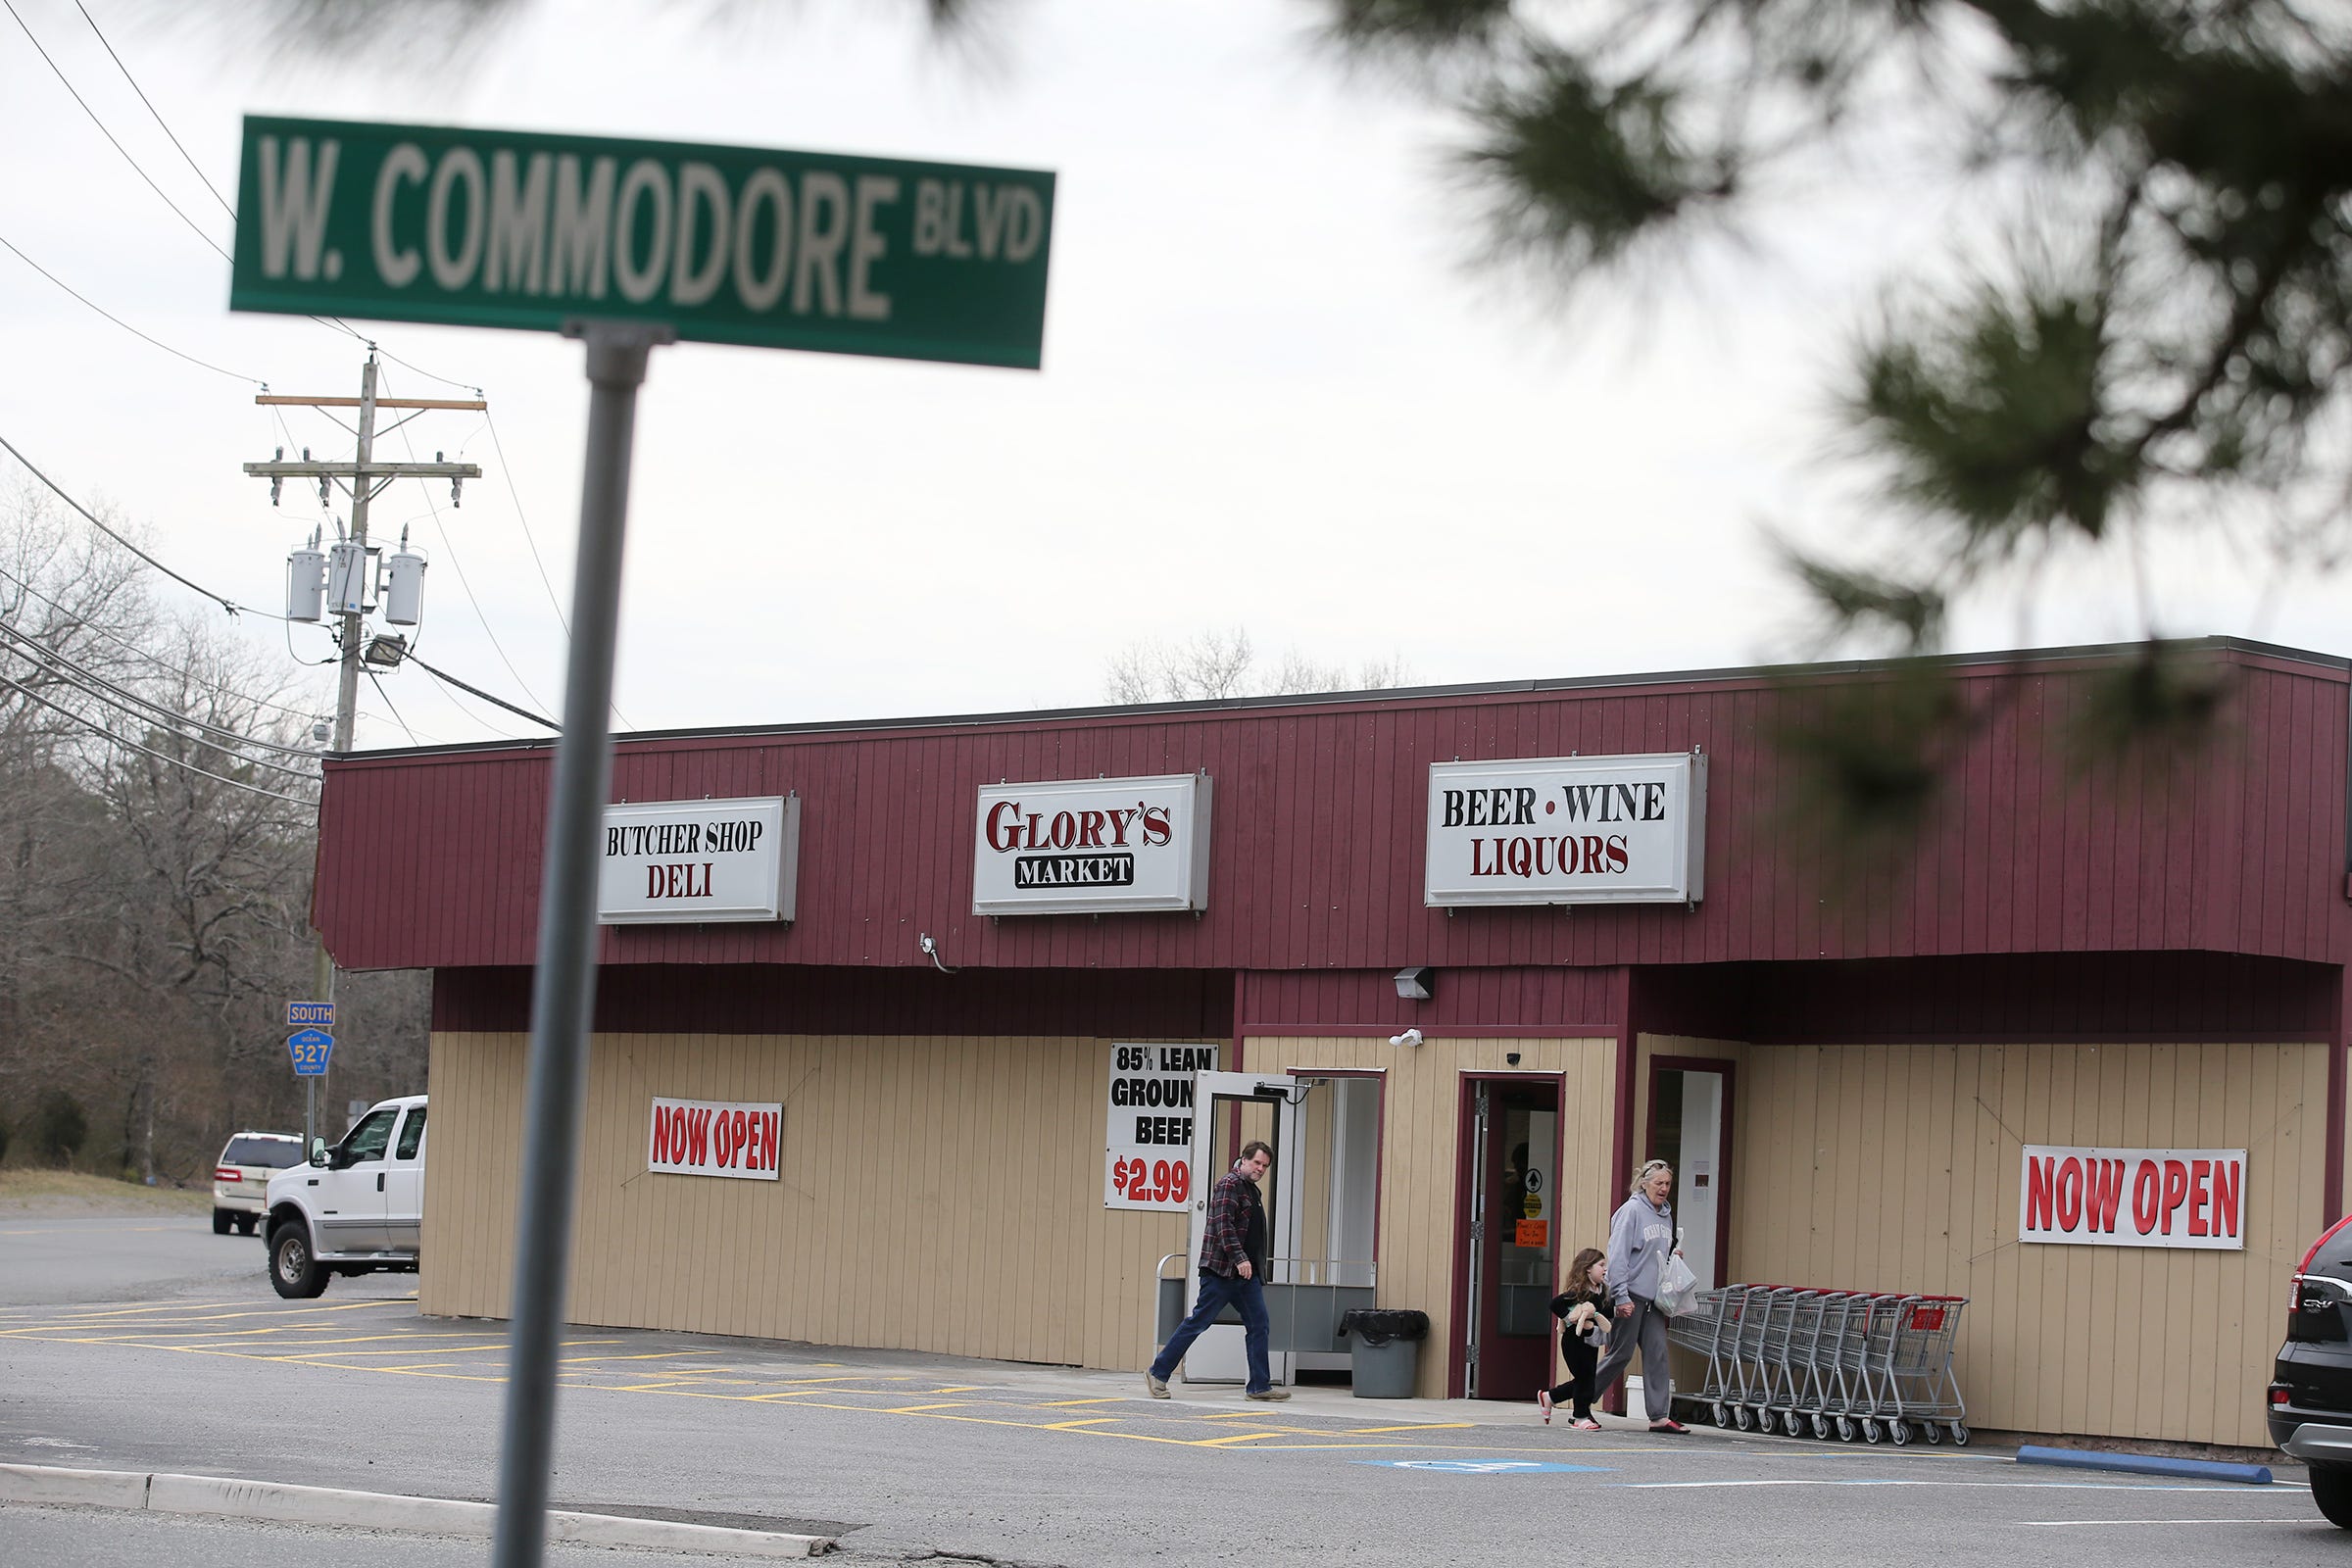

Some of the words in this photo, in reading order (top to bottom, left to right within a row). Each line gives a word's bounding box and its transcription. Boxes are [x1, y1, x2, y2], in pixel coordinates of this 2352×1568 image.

[257, 135, 344, 282] W.
[370, 142, 902, 321] COMMODORE
[912, 178, 1044, 263] BLVD
[1442, 787, 1537, 828] BEER
[1562, 782, 1666, 823] WINE
[606, 823, 701, 857] BUTCHER
[705, 820, 763, 854] SHOP
[986, 801, 1173, 853] GLORY'S
[1018, 857, 1131, 885] MARKET
[1470, 835, 1629, 879] LIQUORS
[646, 862, 713, 899] DELI
[291, 1006, 332, 1021] SOUTH
[295, 1045, 328, 1062] 527
[1116, 1046, 1153, 1071] 85%
[1160, 1047, 1212, 1072] LEAN
[1111, 1078, 1194, 1108] GROUN
[653, 1105, 712, 1166] NOW
[713, 1109, 778, 1171] OPEN
[1135, 1115, 1193, 1146] BEEF
[1113, 1154, 1190, 1203] $2.99
[2027, 1155, 2126, 1234] NOW
[2132, 1158, 2240, 1238] OPEN
